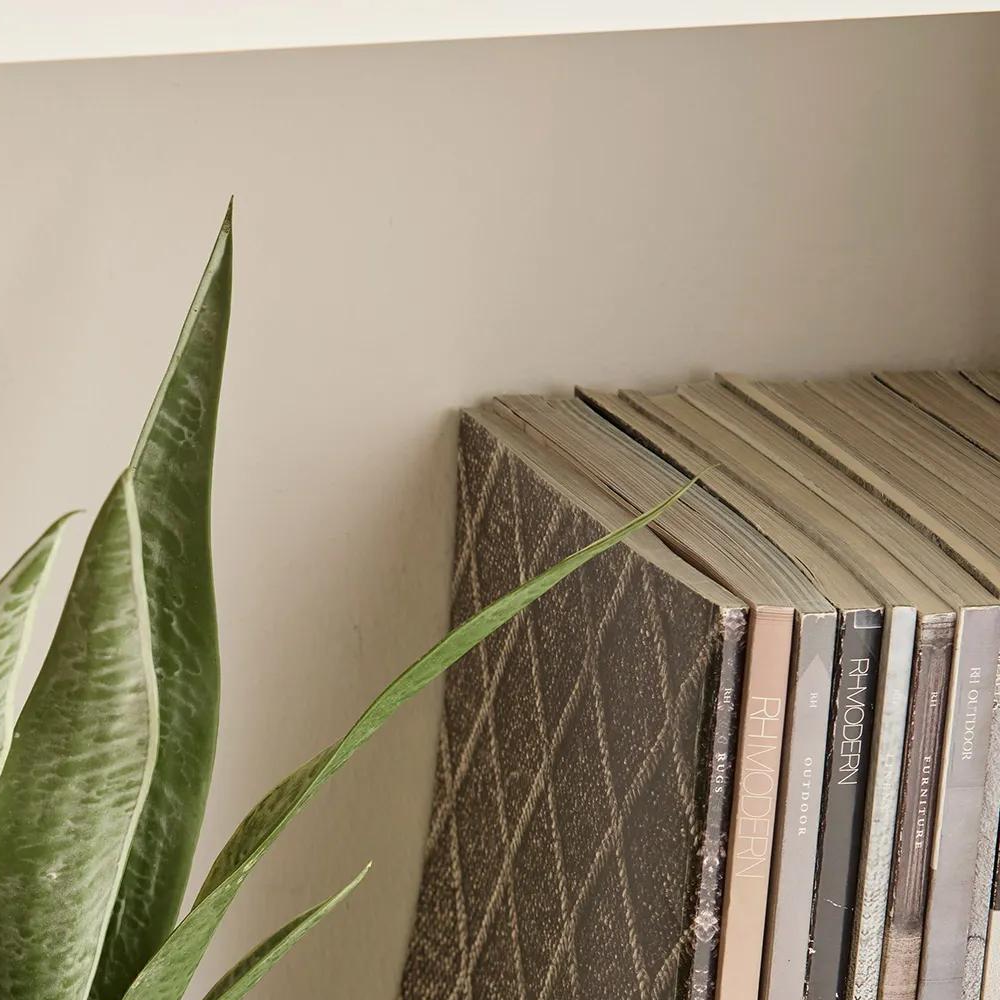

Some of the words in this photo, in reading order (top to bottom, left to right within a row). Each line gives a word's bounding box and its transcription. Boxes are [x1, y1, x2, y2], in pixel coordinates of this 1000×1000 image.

[968, 667, 981, 684] RH
[723, 688, 732, 704] RH
[808, 692, 818, 708] RH
[930, 691, 939, 707] RH
[961, 689, 978, 761] OUTDOOR
[714, 752, 728, 793] RUGS
[798, 757, 813, 836] OUTDOOR
[915, 756, 931, 850] FURNITURE
